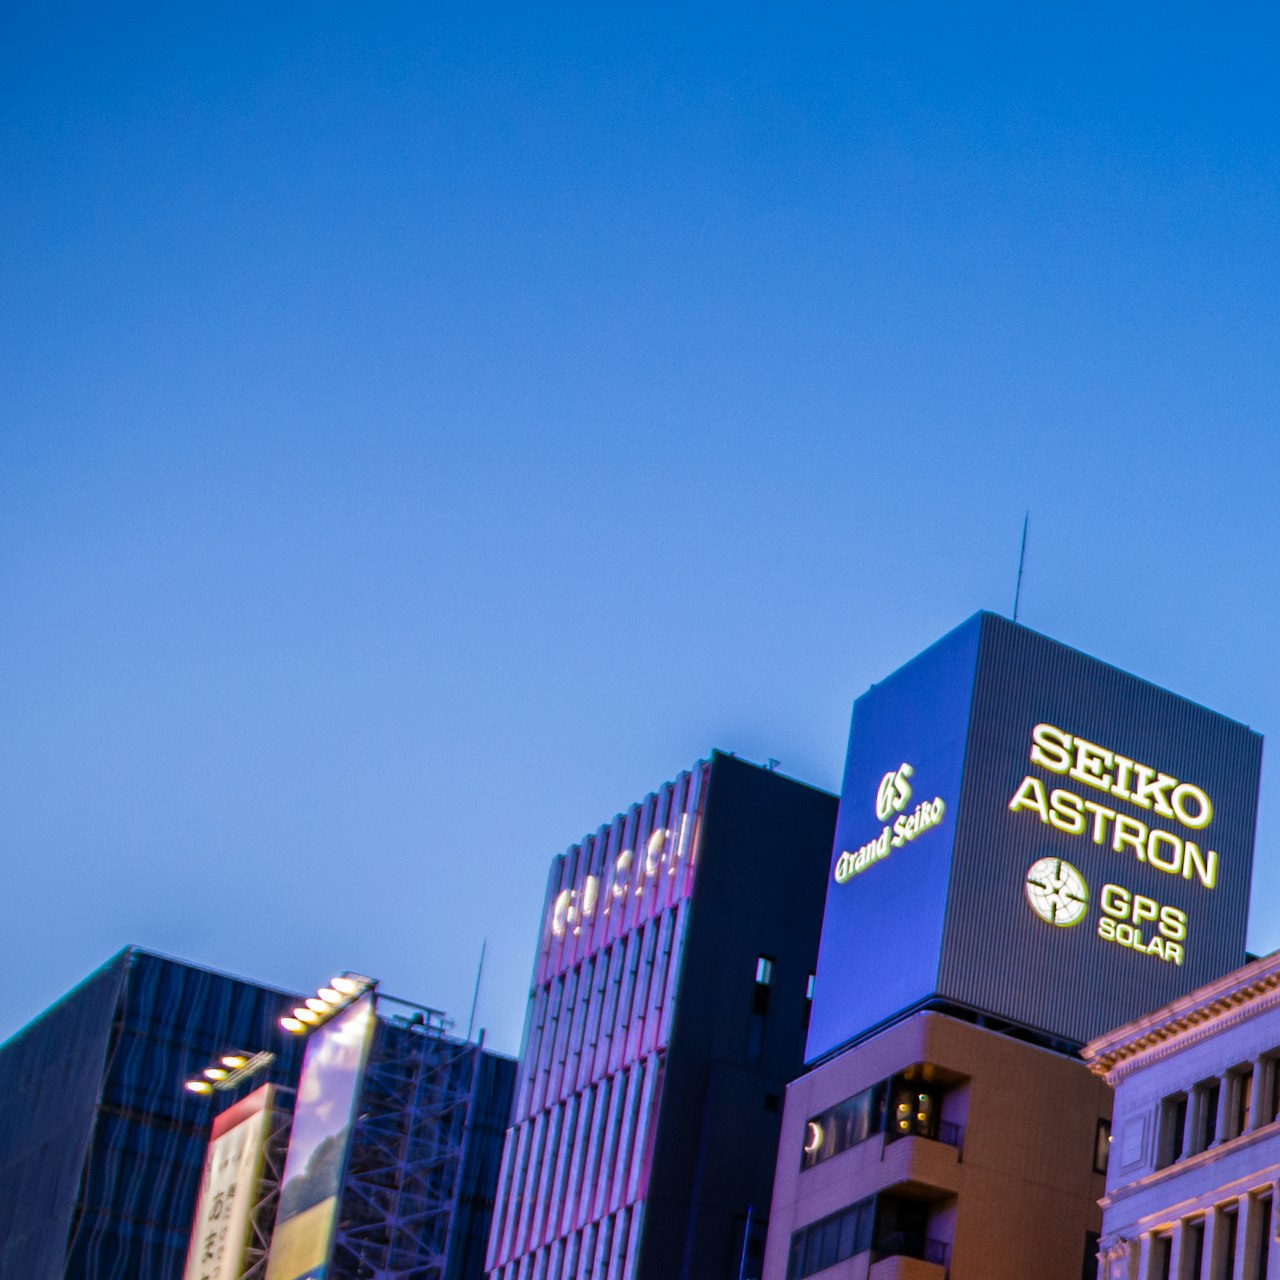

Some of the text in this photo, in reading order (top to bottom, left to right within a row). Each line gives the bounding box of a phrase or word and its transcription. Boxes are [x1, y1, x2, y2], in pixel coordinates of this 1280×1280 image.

[1030, 723, 1214, 829] SEIKO
[834, 796, 945, 884] Grand Seiko
[1008, 775, 1218, 889] ASTRON
[1098, 916, 1185, 966] SOLAR
[1101, 884, 1187, 941] GPS
